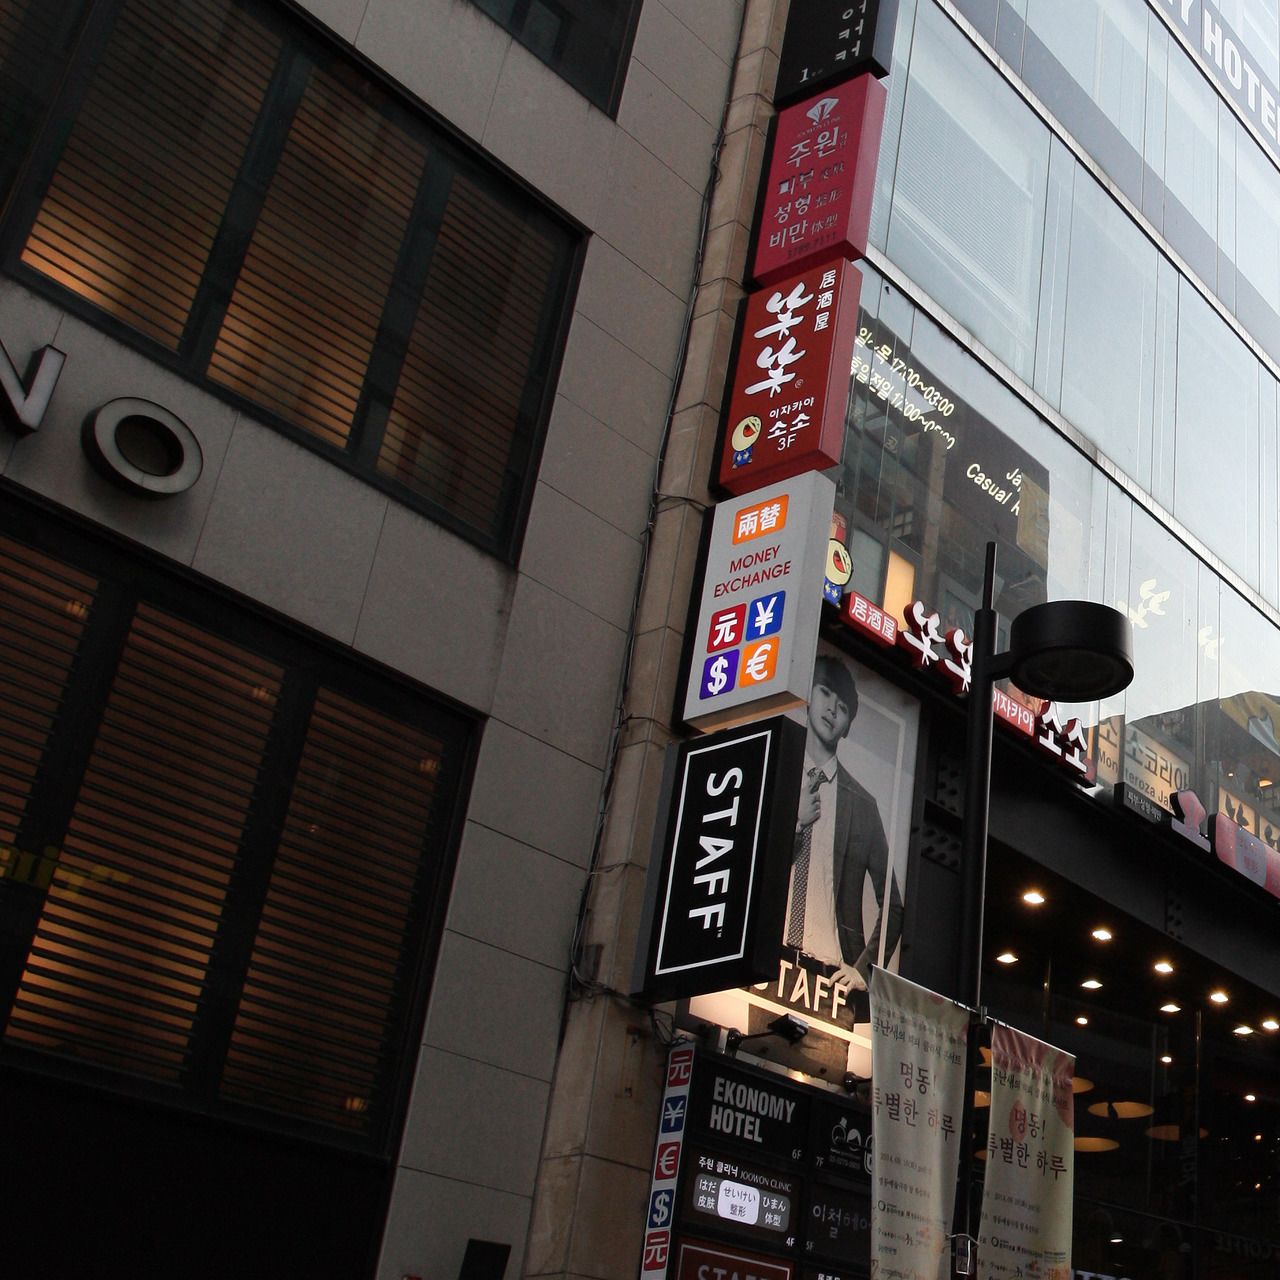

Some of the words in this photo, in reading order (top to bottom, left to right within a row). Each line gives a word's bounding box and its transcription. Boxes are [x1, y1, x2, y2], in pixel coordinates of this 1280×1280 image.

[786, 126, 841, 168] 주원
[774, 194, 813, 224] 성형
[769, 220, 809, 249] 비만
[813, 269, 837, 332] 居酒屋
[769, 396, 816, 420] 이자카야
[767, 412, 811, 440] 소소
[777, 433, 798, 452] 3F
[966, 463, 1013, 506] Casual
[736, 505, 783, 540] 兩替
[728, 544, 782, 575] MONEY
[713, 560, 791, 599] EXCHANGE
[714, 612, 742, 645] 元
[705, 655, 728, 697] $
[745, 641, 774, 684] €
[851, 595, 897, 640] 居酒屋
[1038, 699, 1089, 774] 소소
[688, 766, 744, 937] STAFF
[669, 1054, 694, 1081] 元
[712, 1075, 797, 1124] EKONOMY
[709, 1104, 764, 1145] HOTEL
[698, 1155, 715, 1171] 주원
[769, 1176, 793, 1193] CLINIC
[1036, 1150, 1068, 1181] 하루
[699, 1178, 717, 1194] はだ
[762, 1195, 787, 1212] ひまん
[645, 1237, 667, 1266] 元
[785, 1236, 796, 1248] 4F
